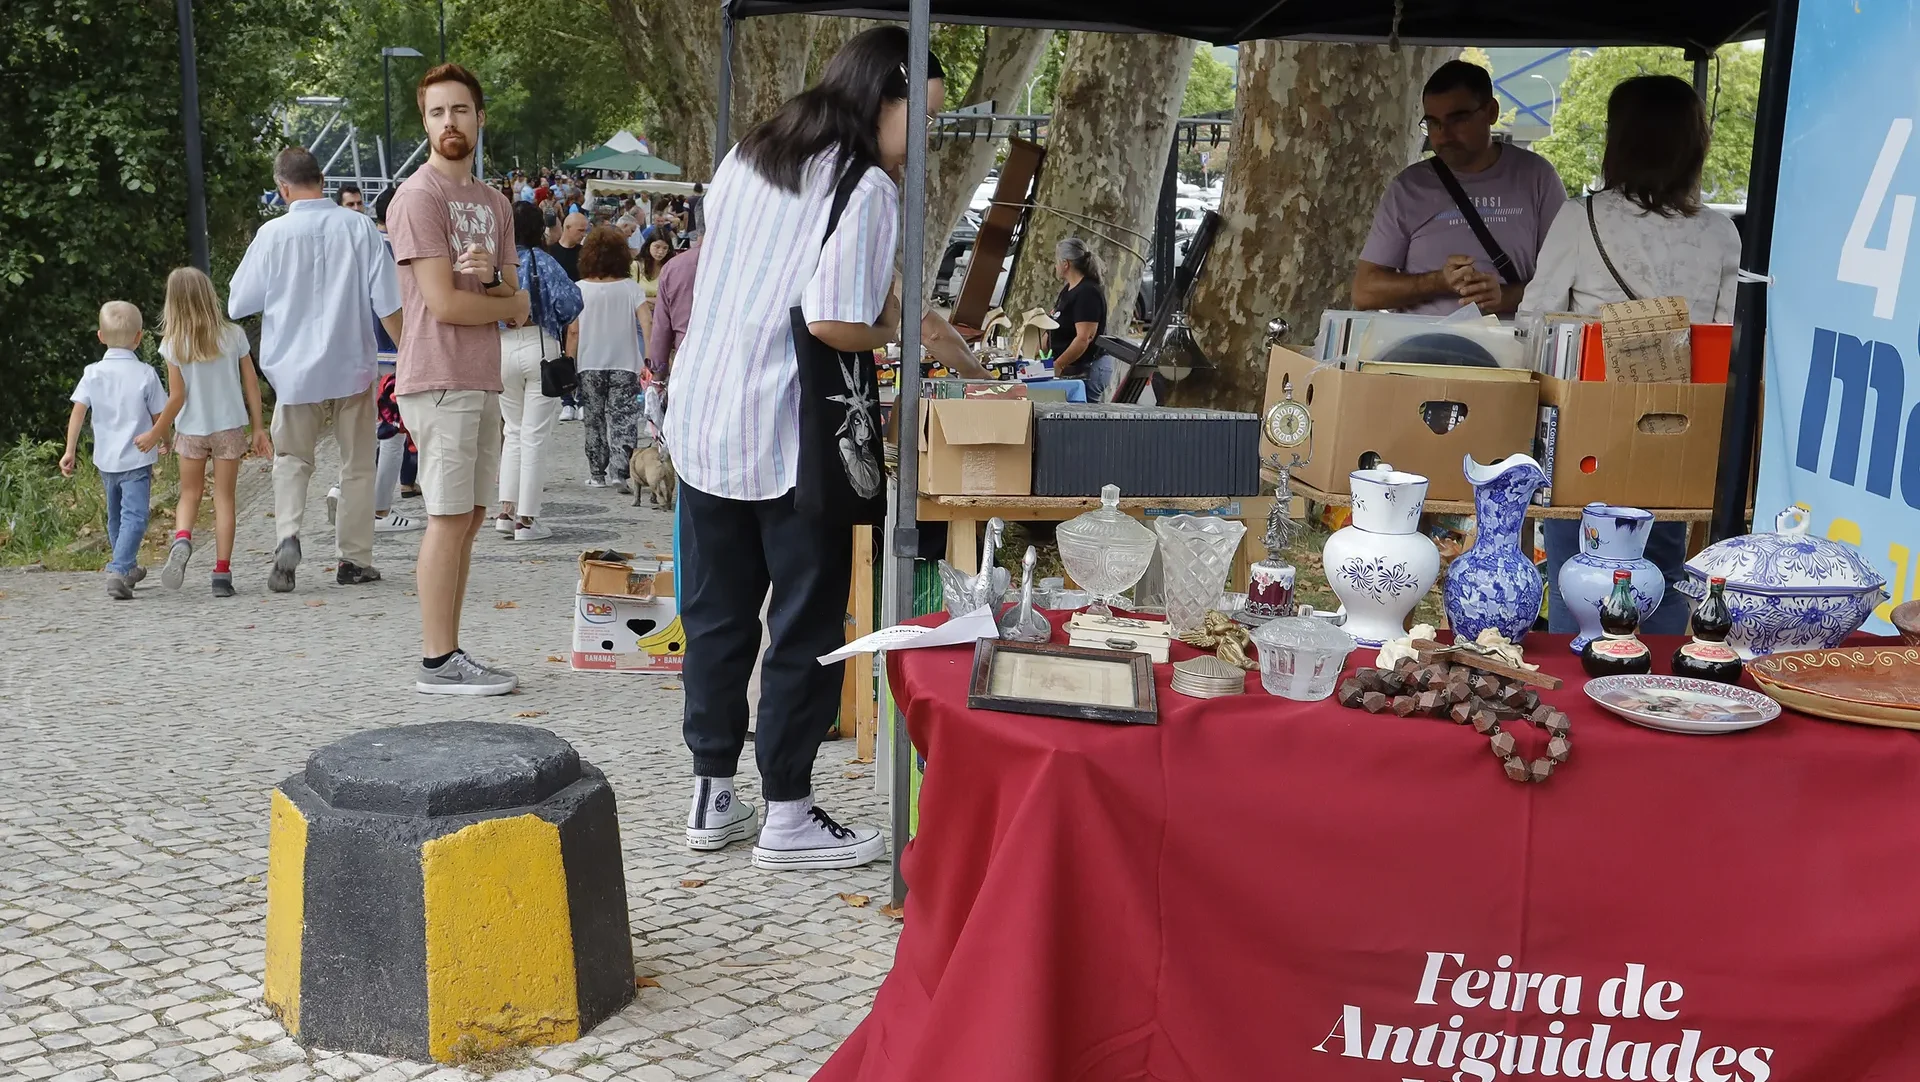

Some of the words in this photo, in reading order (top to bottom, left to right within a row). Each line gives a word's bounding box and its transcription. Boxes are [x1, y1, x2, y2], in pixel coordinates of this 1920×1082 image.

[1836, 117, 1917, 321] 4
[1610, 354, 1622, 374] Leya
[1796, 326, 1920, 511] m
[1549, 427, 1557, 446] COSTA
[1548, 446, 1554, 456] DO
[587, 603, 613, 614] Dole
[585, 655, 616, 663] BANANAS
[1414, 952, 1582, 1015] Feira
[1598, 962, 1684, 1021] de
[1312, 1003, 1775, 1082] Antiguidades
